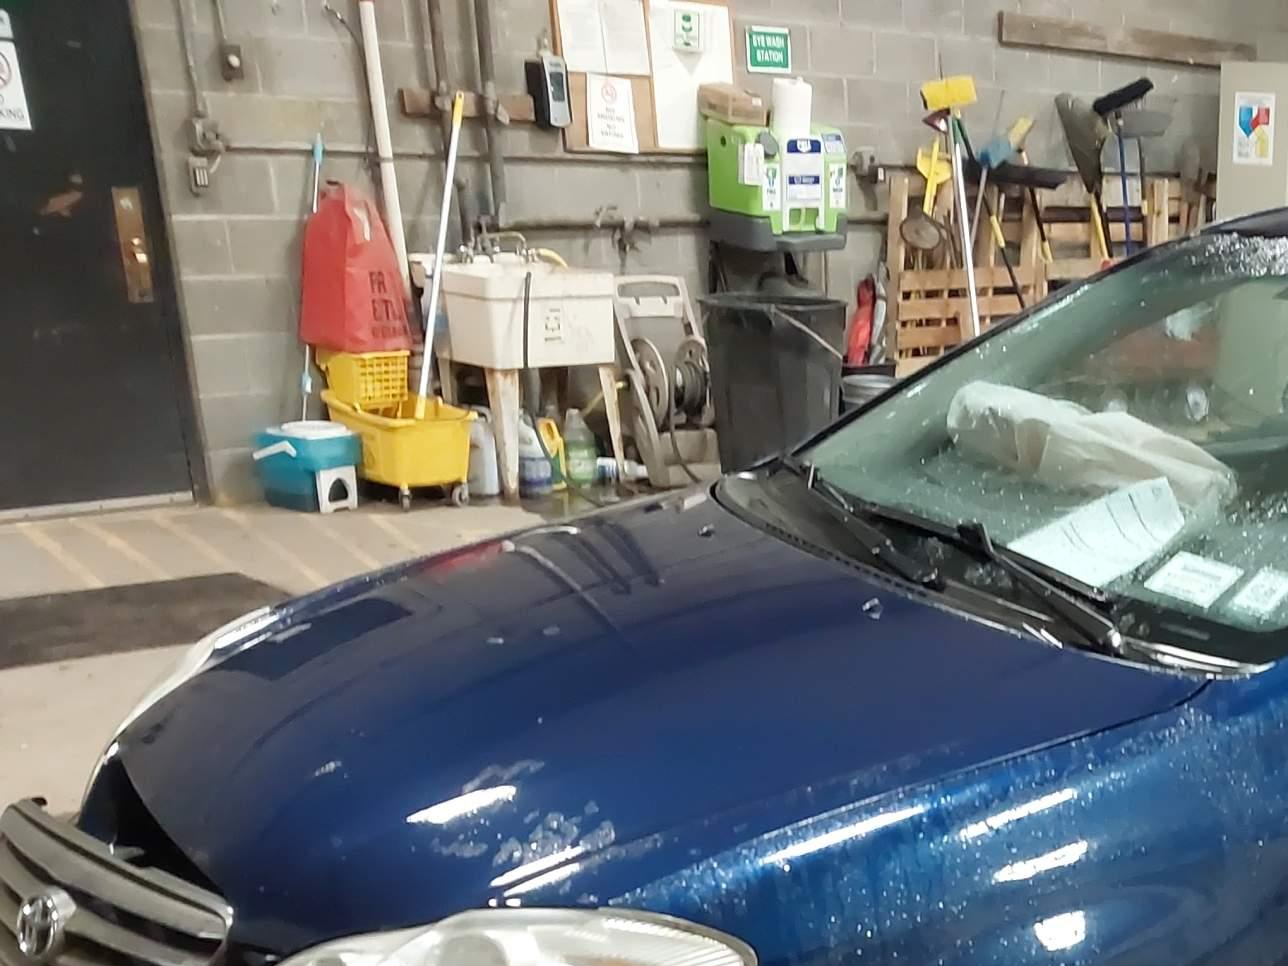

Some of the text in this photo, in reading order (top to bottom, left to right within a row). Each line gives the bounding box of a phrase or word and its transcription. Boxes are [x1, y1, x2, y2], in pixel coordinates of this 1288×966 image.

[752, 34, 785, 48] EYE WASH
[756, 49, 784, 63] STATION
